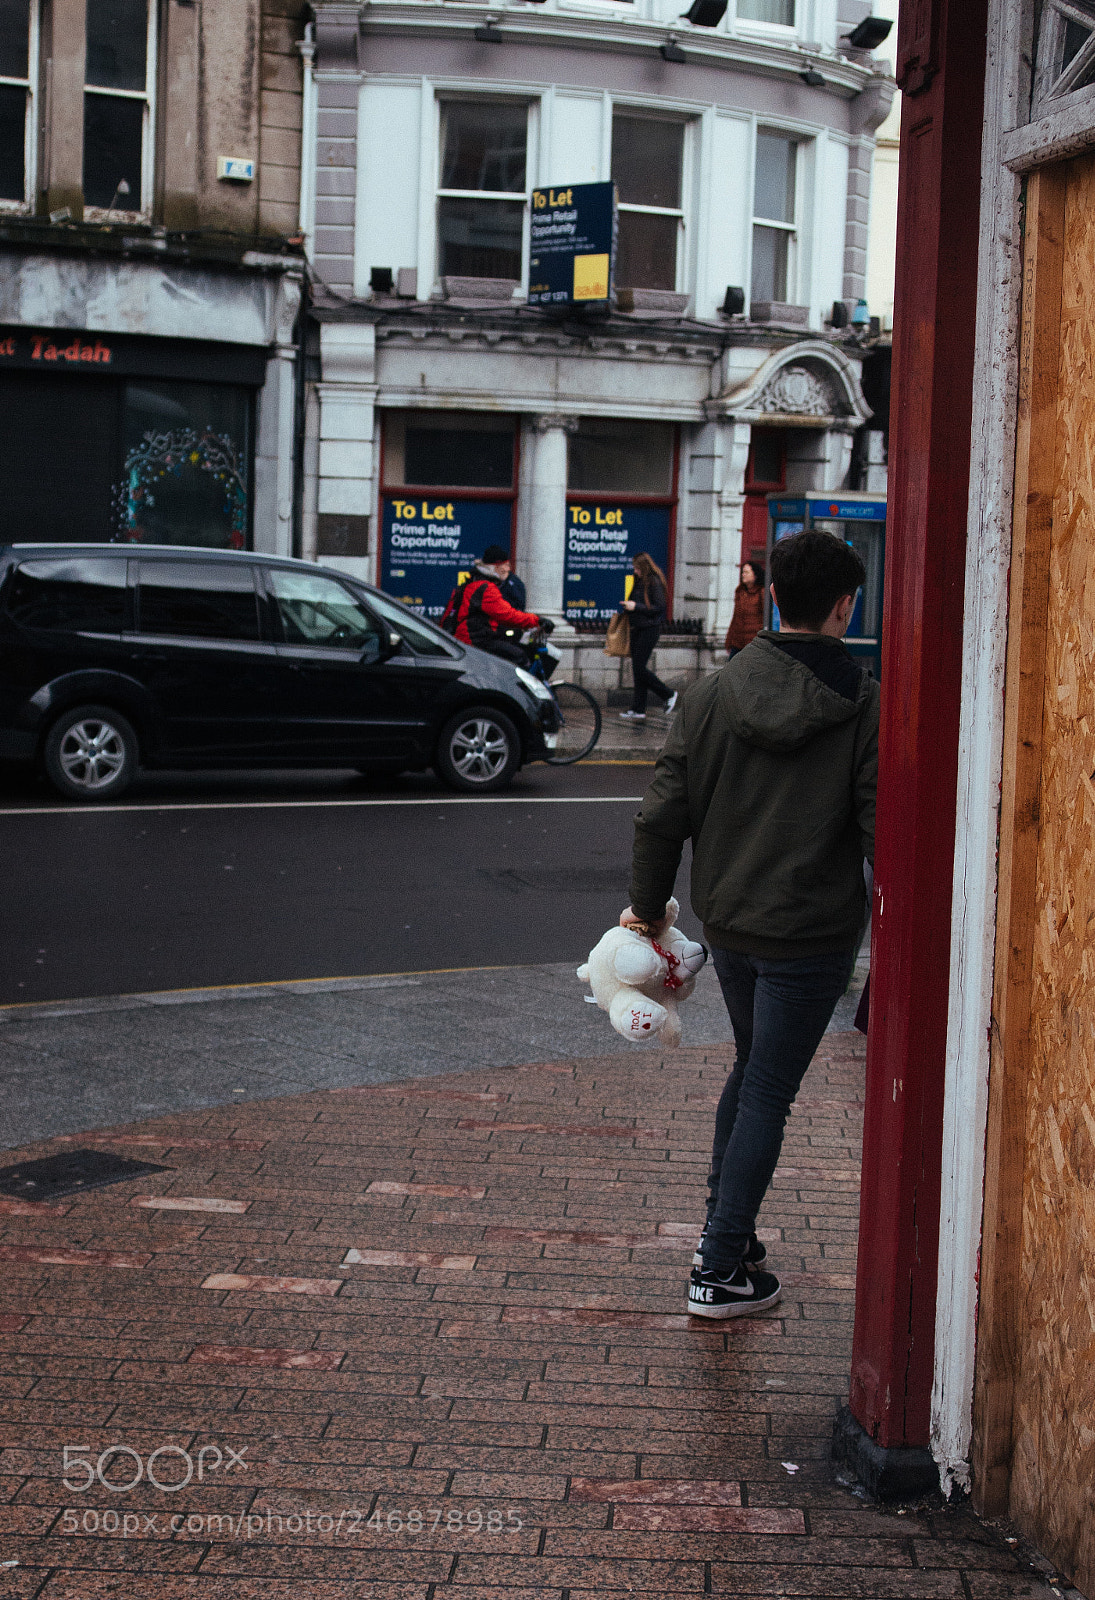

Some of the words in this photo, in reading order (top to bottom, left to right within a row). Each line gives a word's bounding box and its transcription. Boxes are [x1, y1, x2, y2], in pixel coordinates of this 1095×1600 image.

[532, 191, 546, 209] To
[549, 188, 573, 207] Let
[553, 209, 578, 221] Retail
[532, 223, 577, 237] Opportunity
[31, 336, 111, 362] Ta-dah
[391, 500, 416, 519] To
[421, 501, 454, 520] Let
[569, 506, 591, 524] To
[595, 507, 623, 525] Let
[391, 523, 426, 536] Prime
[427, 524, 461, 536] Retail
[569, 528, 599, 540] Prime
[600, 529, 628, 541] Retail
[391, 535, 460, 551] Opportunity
[568, 540, 627, 554] Opportunity
[566, 609, 581, 618] 021
[583, 609, 598, 618] 427
[631, 1010, 641, 1031] you
[689, 1284, 714, 1303] IKE
